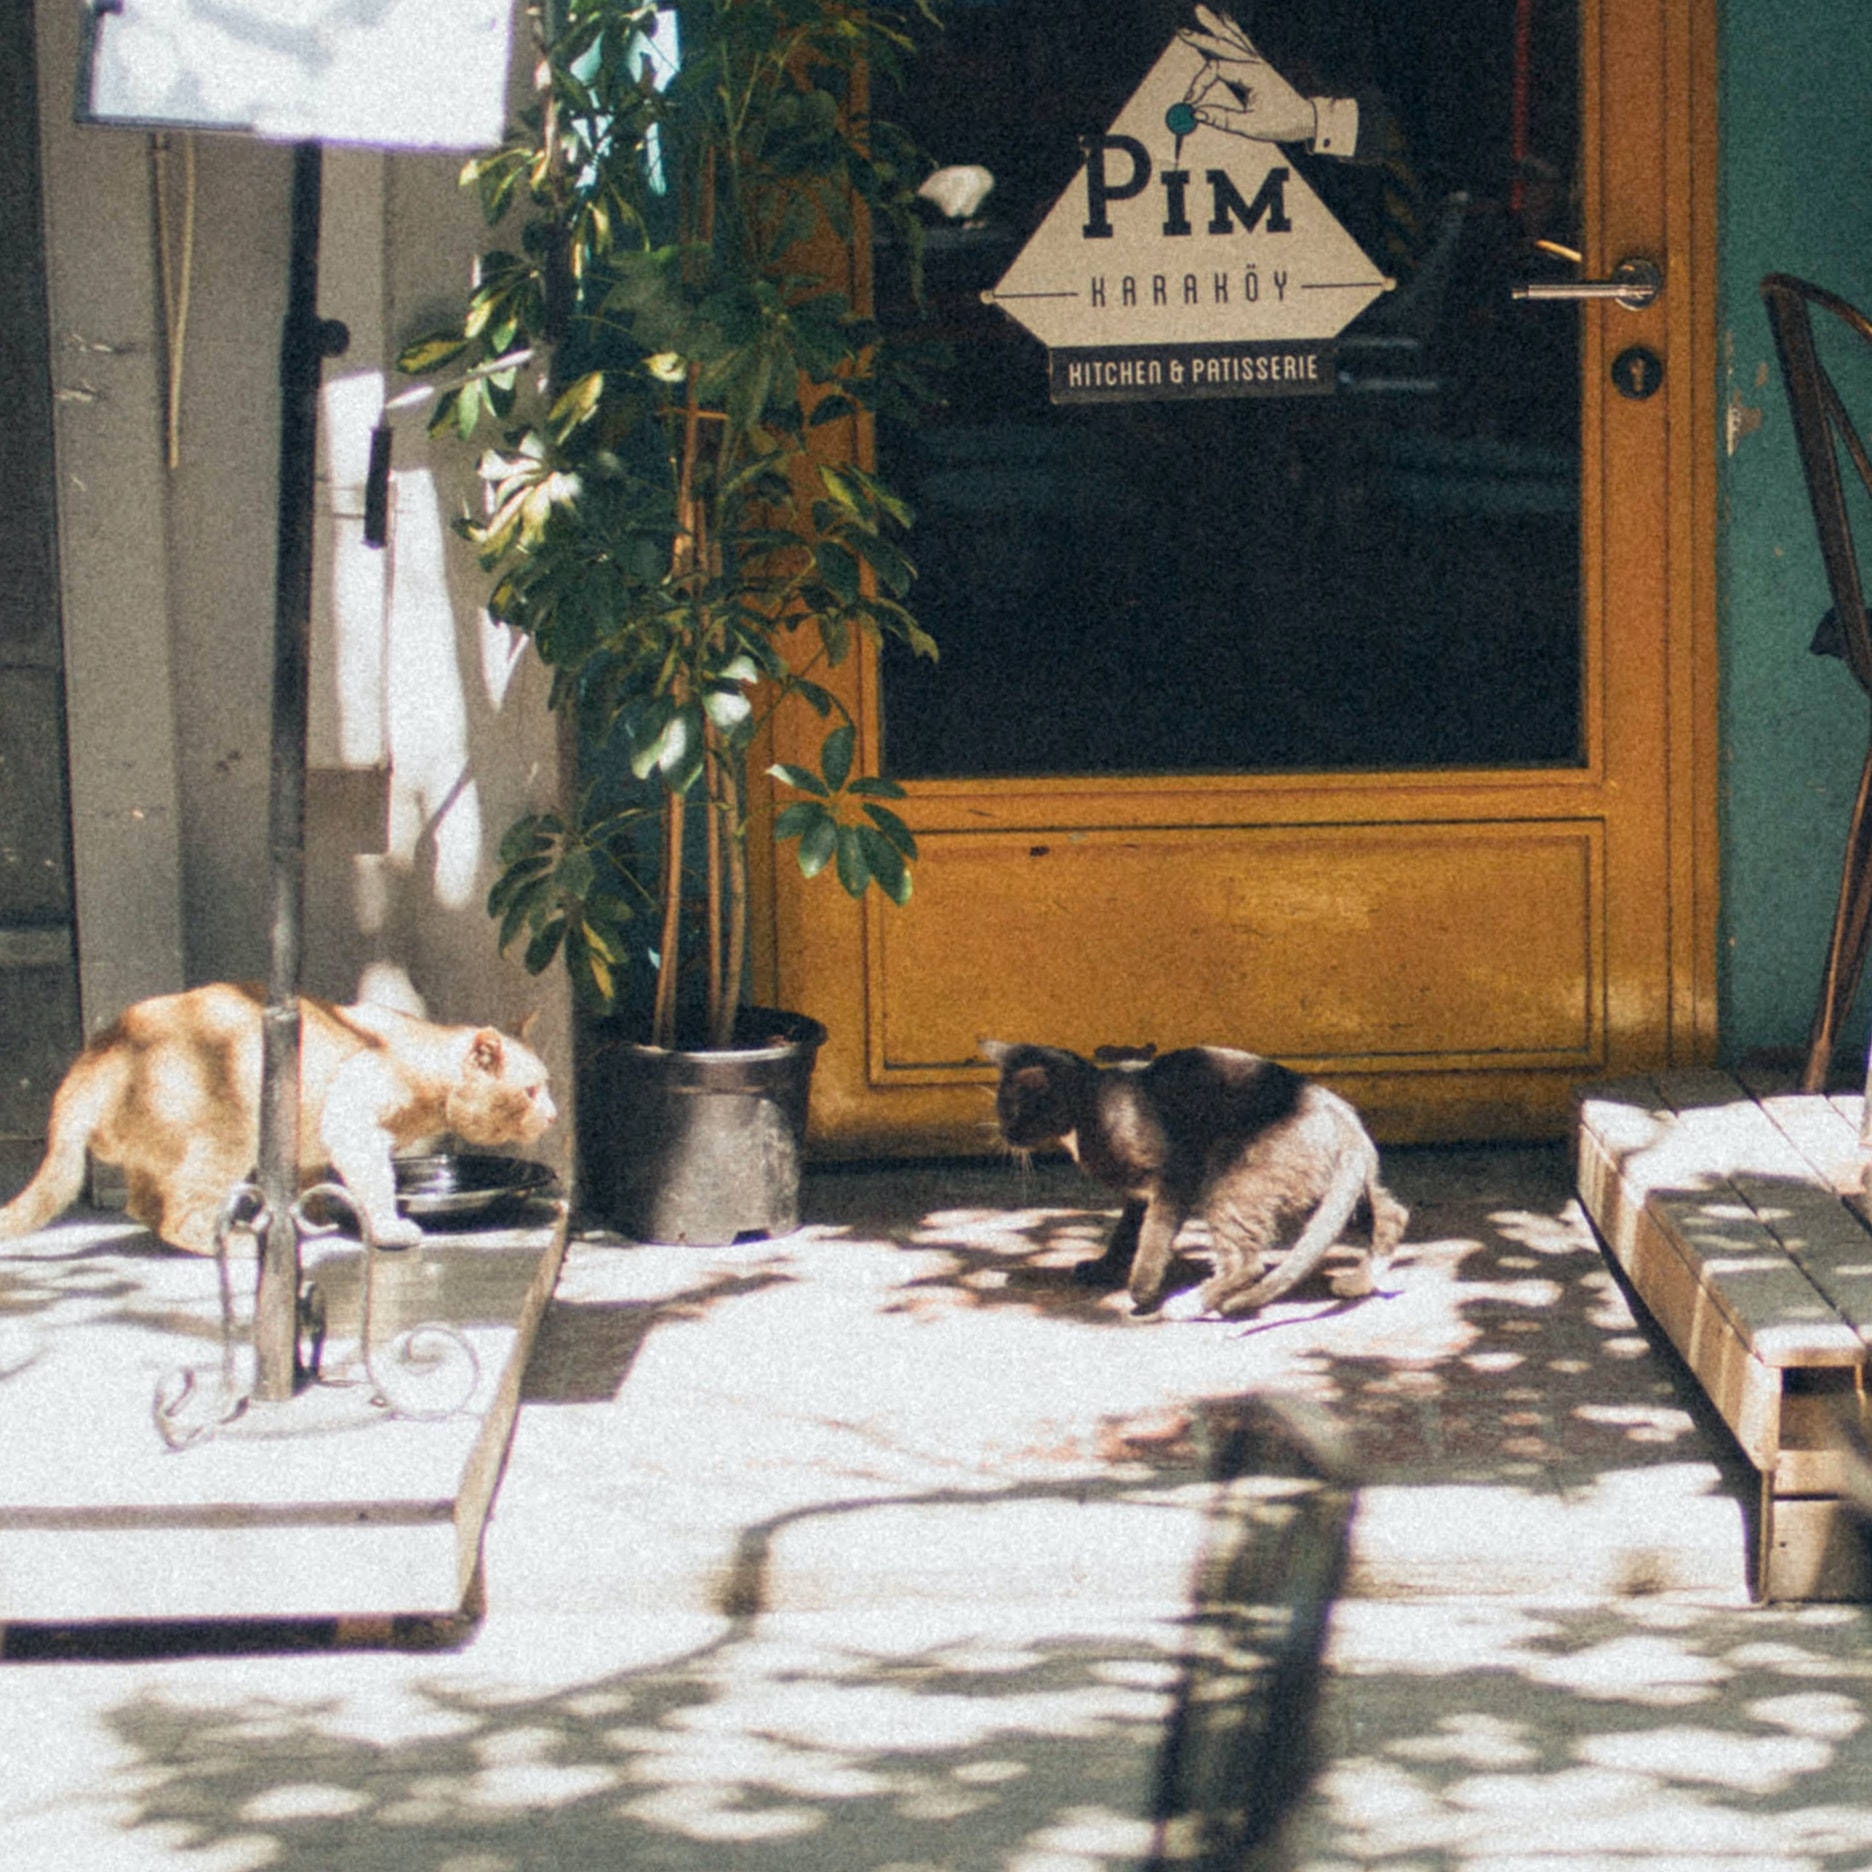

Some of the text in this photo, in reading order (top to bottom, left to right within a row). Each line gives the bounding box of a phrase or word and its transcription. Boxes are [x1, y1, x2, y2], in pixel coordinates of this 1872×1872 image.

[1090, 263, 1289, 308] KARAKÖY
[1068, 354, 1319, 388] KITCHEN & PATISSERIE
